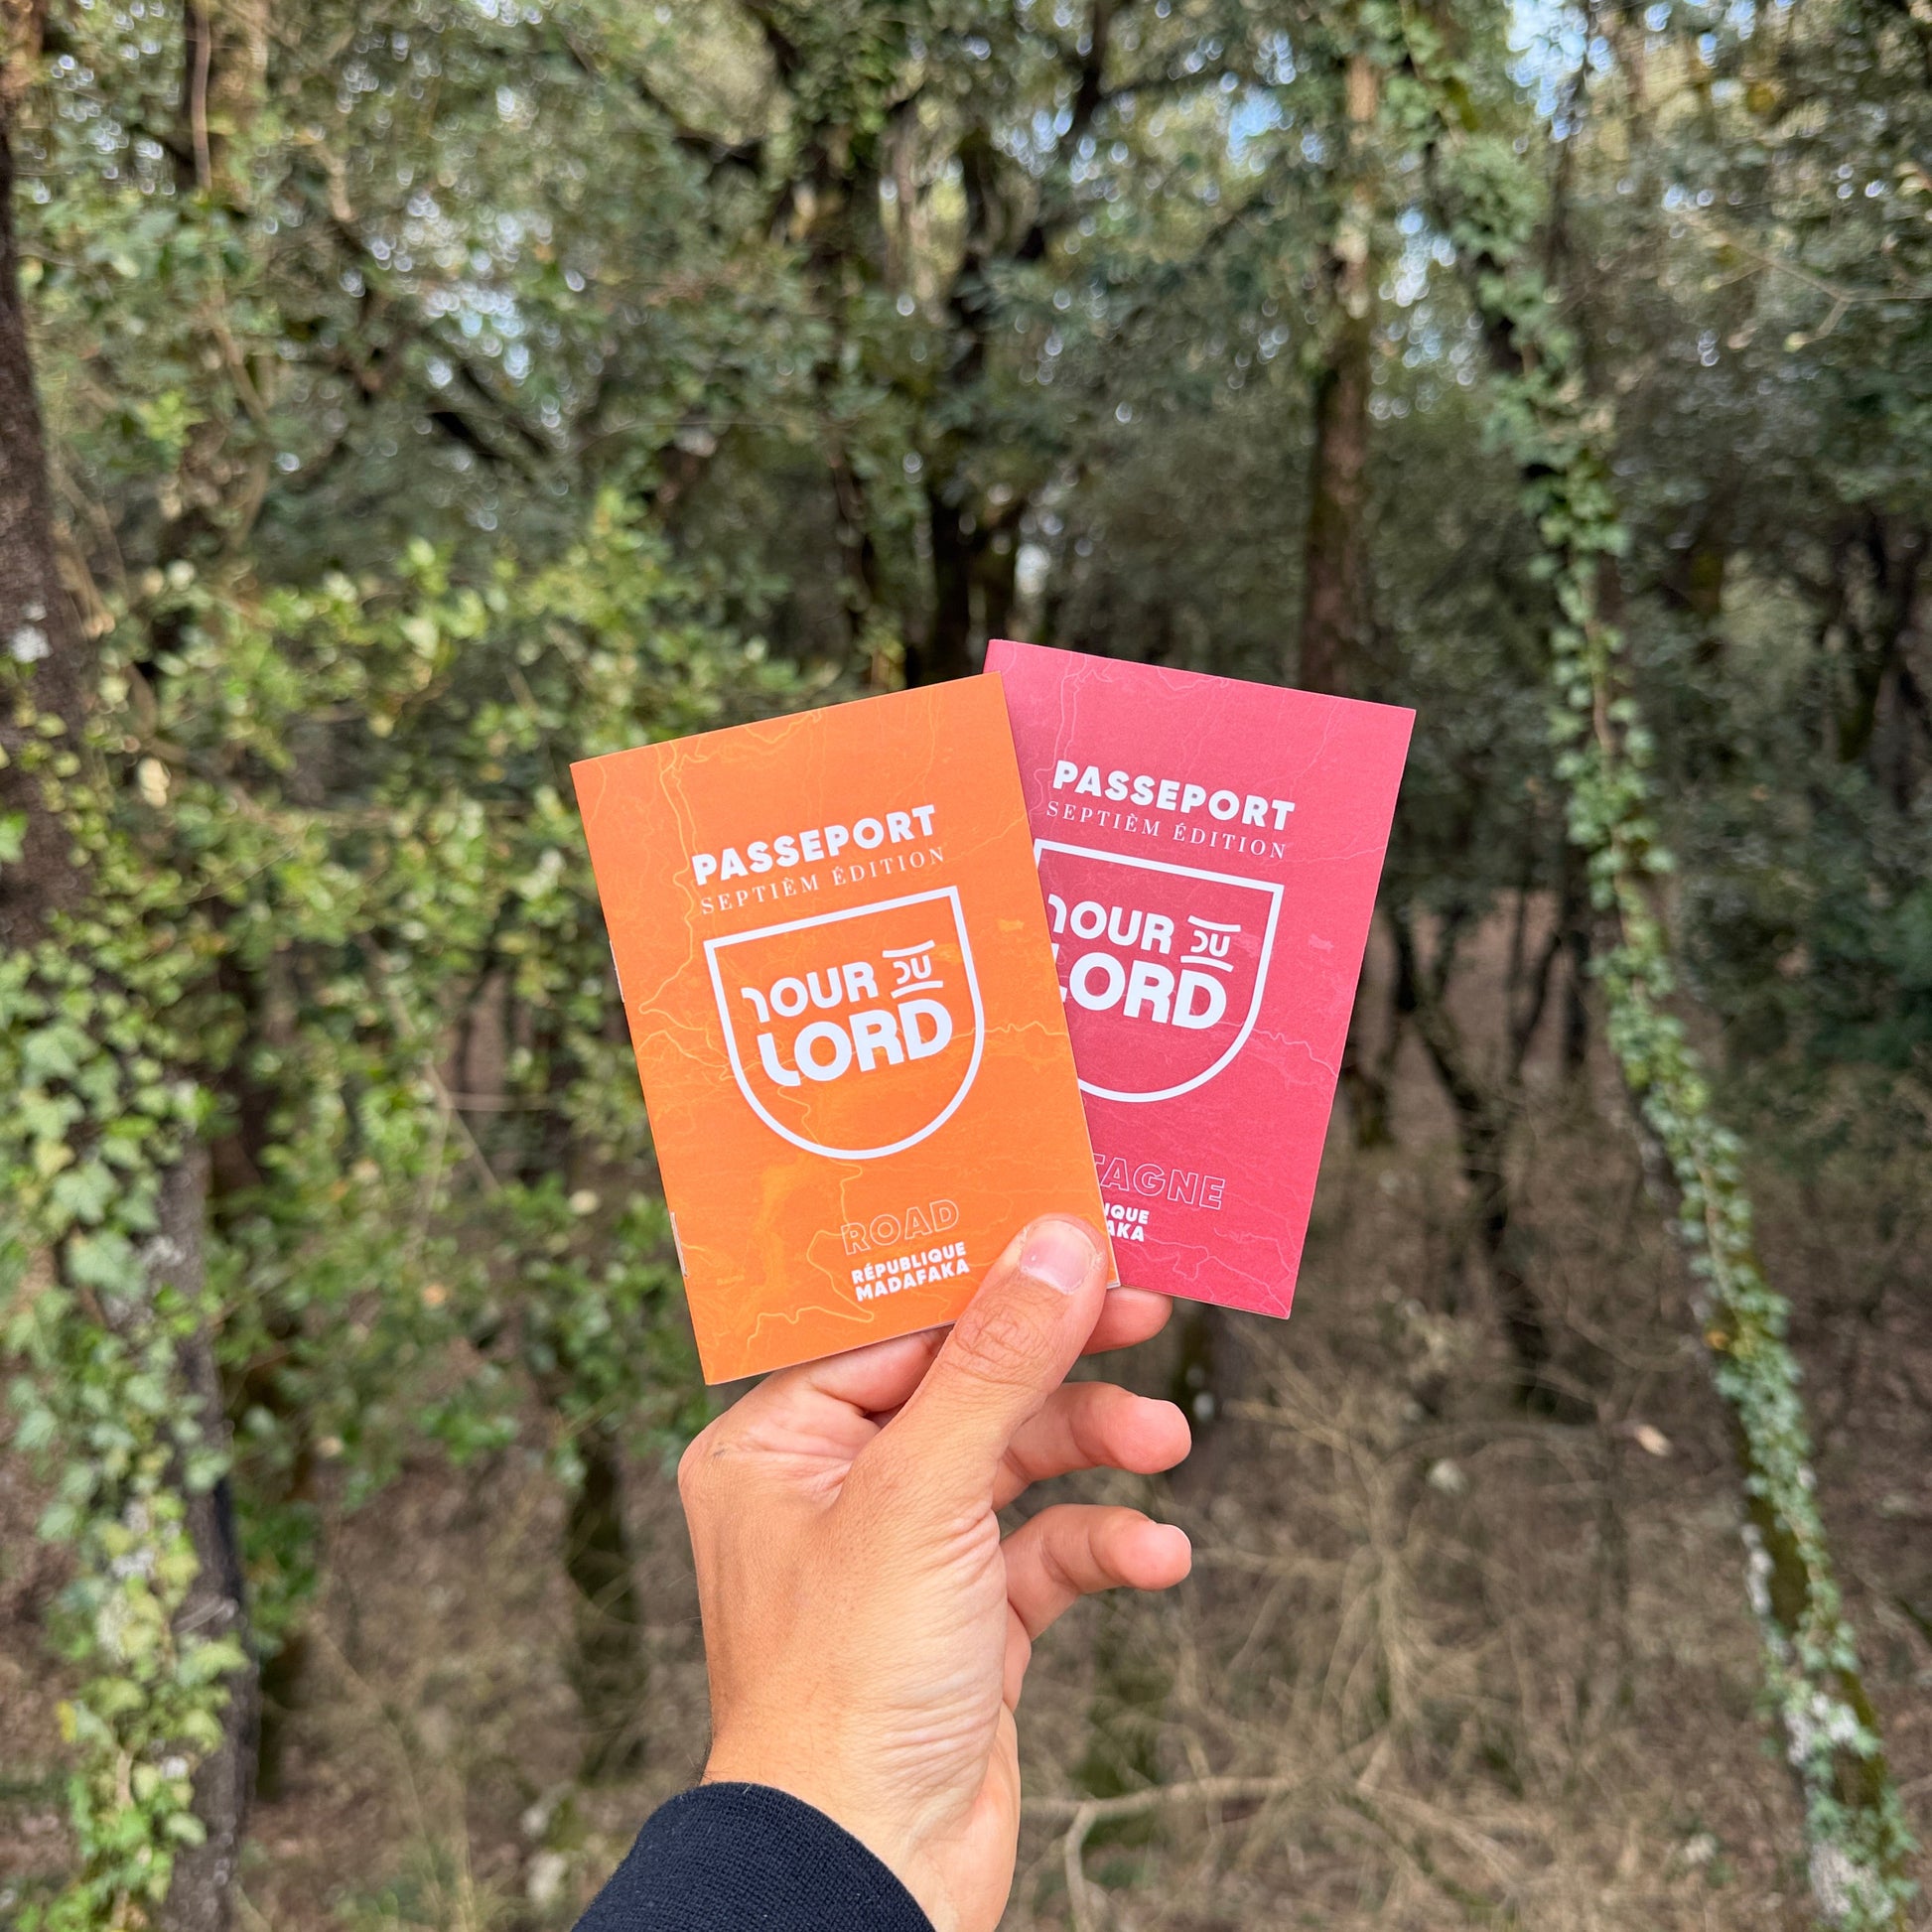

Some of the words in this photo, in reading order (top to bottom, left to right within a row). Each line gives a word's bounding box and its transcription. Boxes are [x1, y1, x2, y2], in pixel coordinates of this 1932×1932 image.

[1052, 759, 1296, 831] PASSEPORT
[691, 804, 936, 886] PASSEPORT
[1046, 800, 1161, 837] SEPTIÈM
[1173, 822, 1287, 860] ÉDITION
[701, 874, 820, 914] SEPTIÈM
[833, 846, 946, 887] ÉDITION
[741, 961, 879, 1024] TOUR
[757, 998, 953, 1086] LORD
[840, 1198, 960, 1256] ROAD
[851, 1241, 966, 1285] RÉPUBLIQUE
[855, 1258, 970, 1302] MADAFAKA
